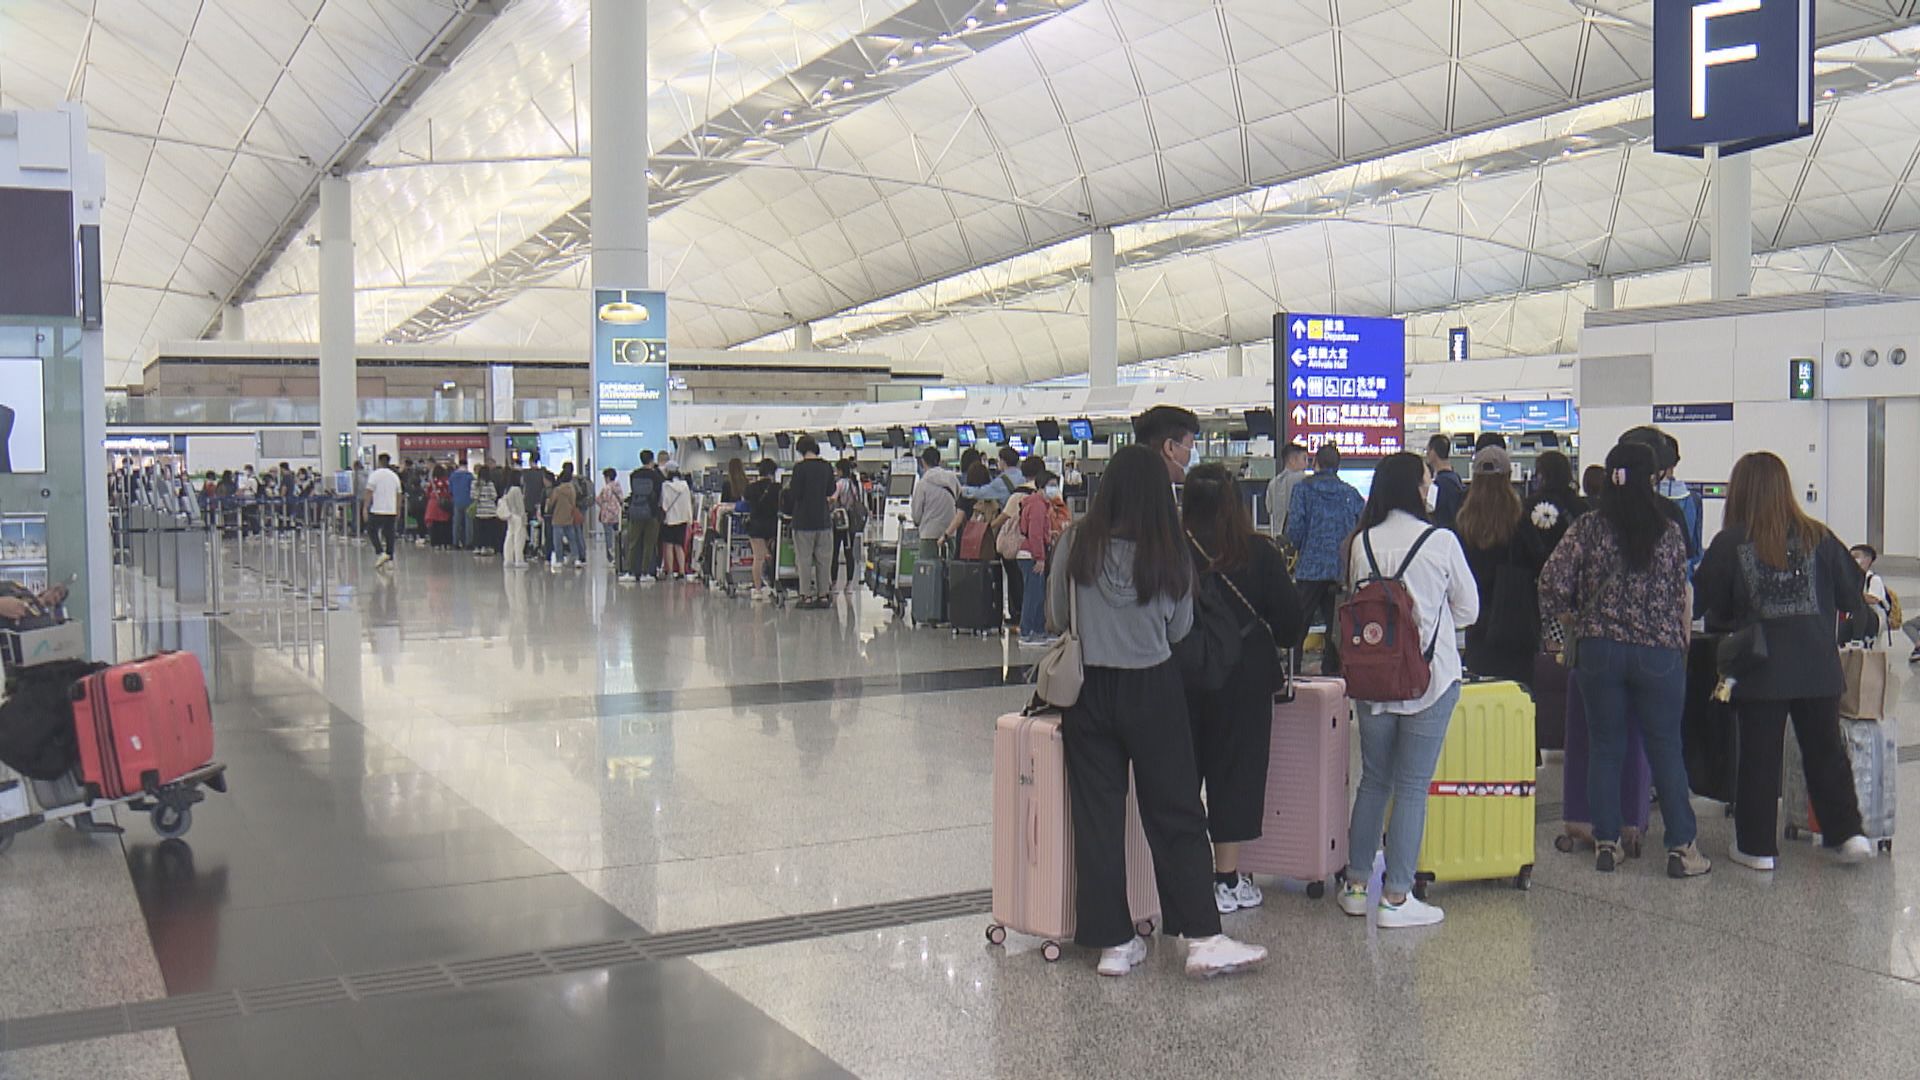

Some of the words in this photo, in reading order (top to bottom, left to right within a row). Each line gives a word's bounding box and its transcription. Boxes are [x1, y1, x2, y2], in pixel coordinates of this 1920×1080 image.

[1691, 0, 1761, 119] F
[1324, 331, 1360, 342] Departures
[1308, 359, 1334, 369] Arrivals
[1334, 359, 1348, 369] Hall
